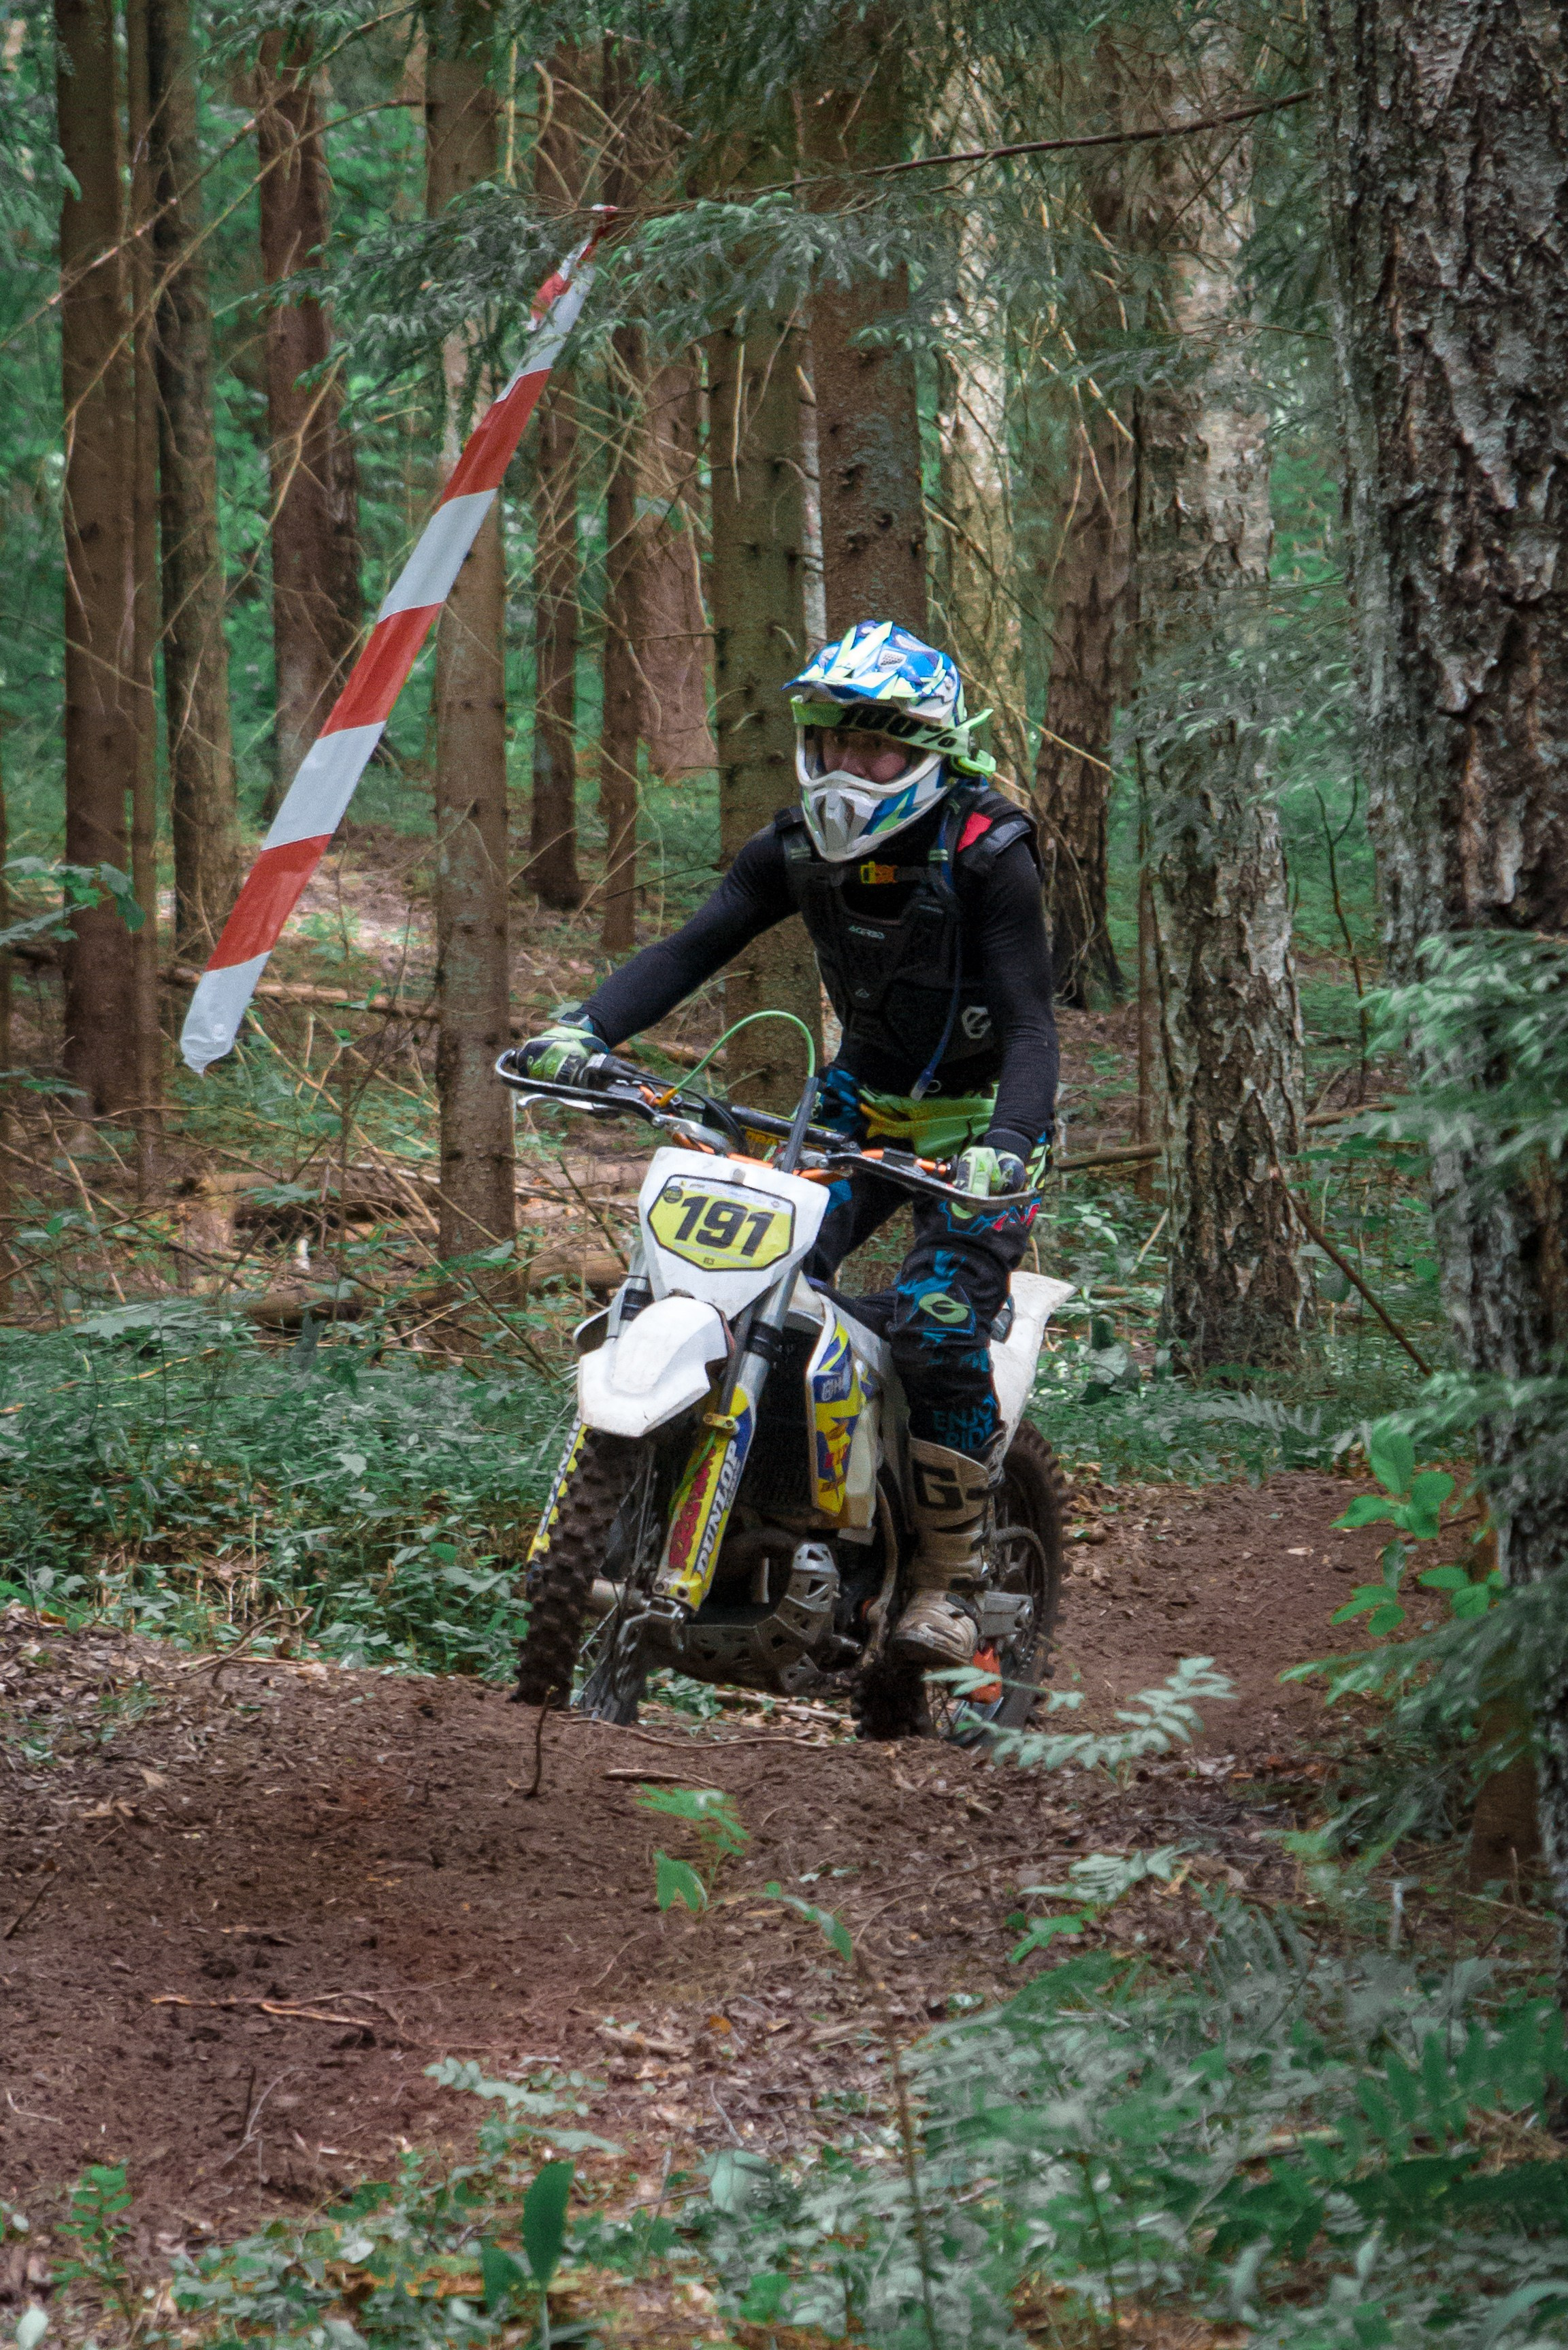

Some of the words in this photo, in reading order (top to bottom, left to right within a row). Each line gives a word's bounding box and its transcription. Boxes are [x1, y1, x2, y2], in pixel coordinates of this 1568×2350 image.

[837, 703, 958, 748] 100%
[674, 1195, 776, 1258] 191
[696, 1439, 738, 1581] DUNLOP
